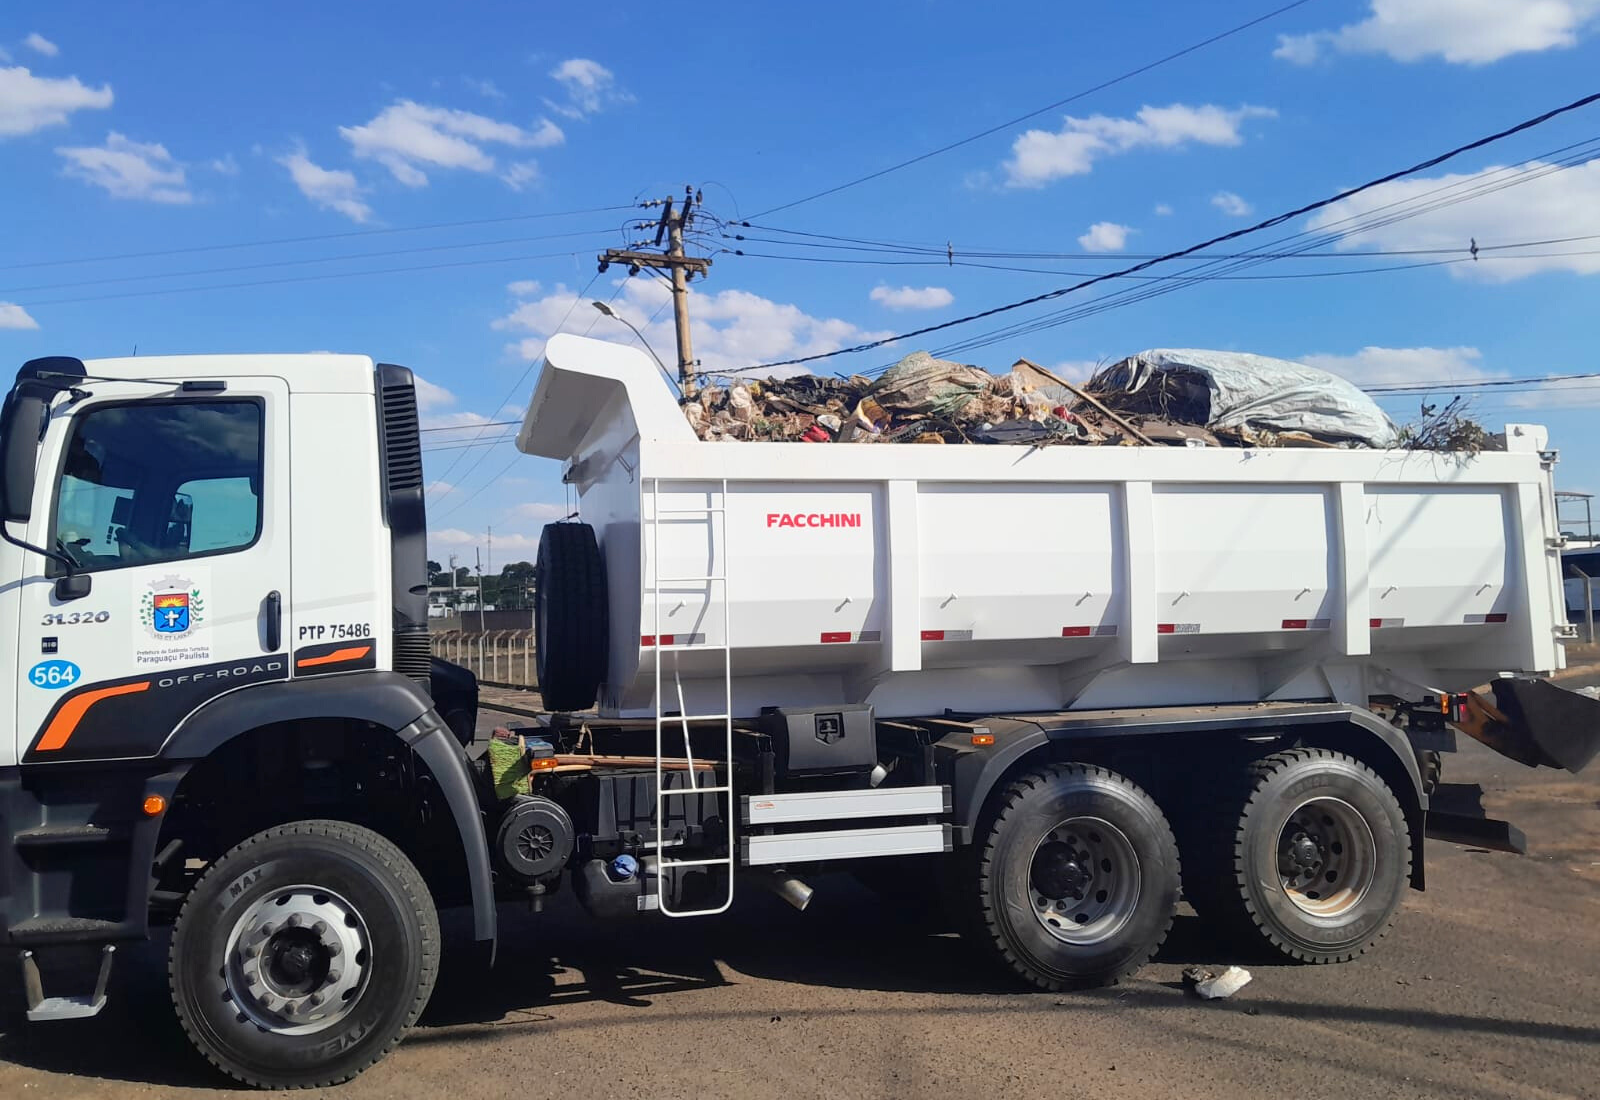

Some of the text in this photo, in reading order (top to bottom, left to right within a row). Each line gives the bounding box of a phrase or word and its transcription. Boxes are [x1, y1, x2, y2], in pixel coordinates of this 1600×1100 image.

[766, 513, 861, 528] FACCHINI
[299, 623, 371, 640] PTP 75486
[136, 651, 210, 664] Paraguaçu Paulista
[34, 664, 75, 685] 564
[158, 662, 282, 688] OFF-ROAD
[230, 868, 262, 899] MAX
